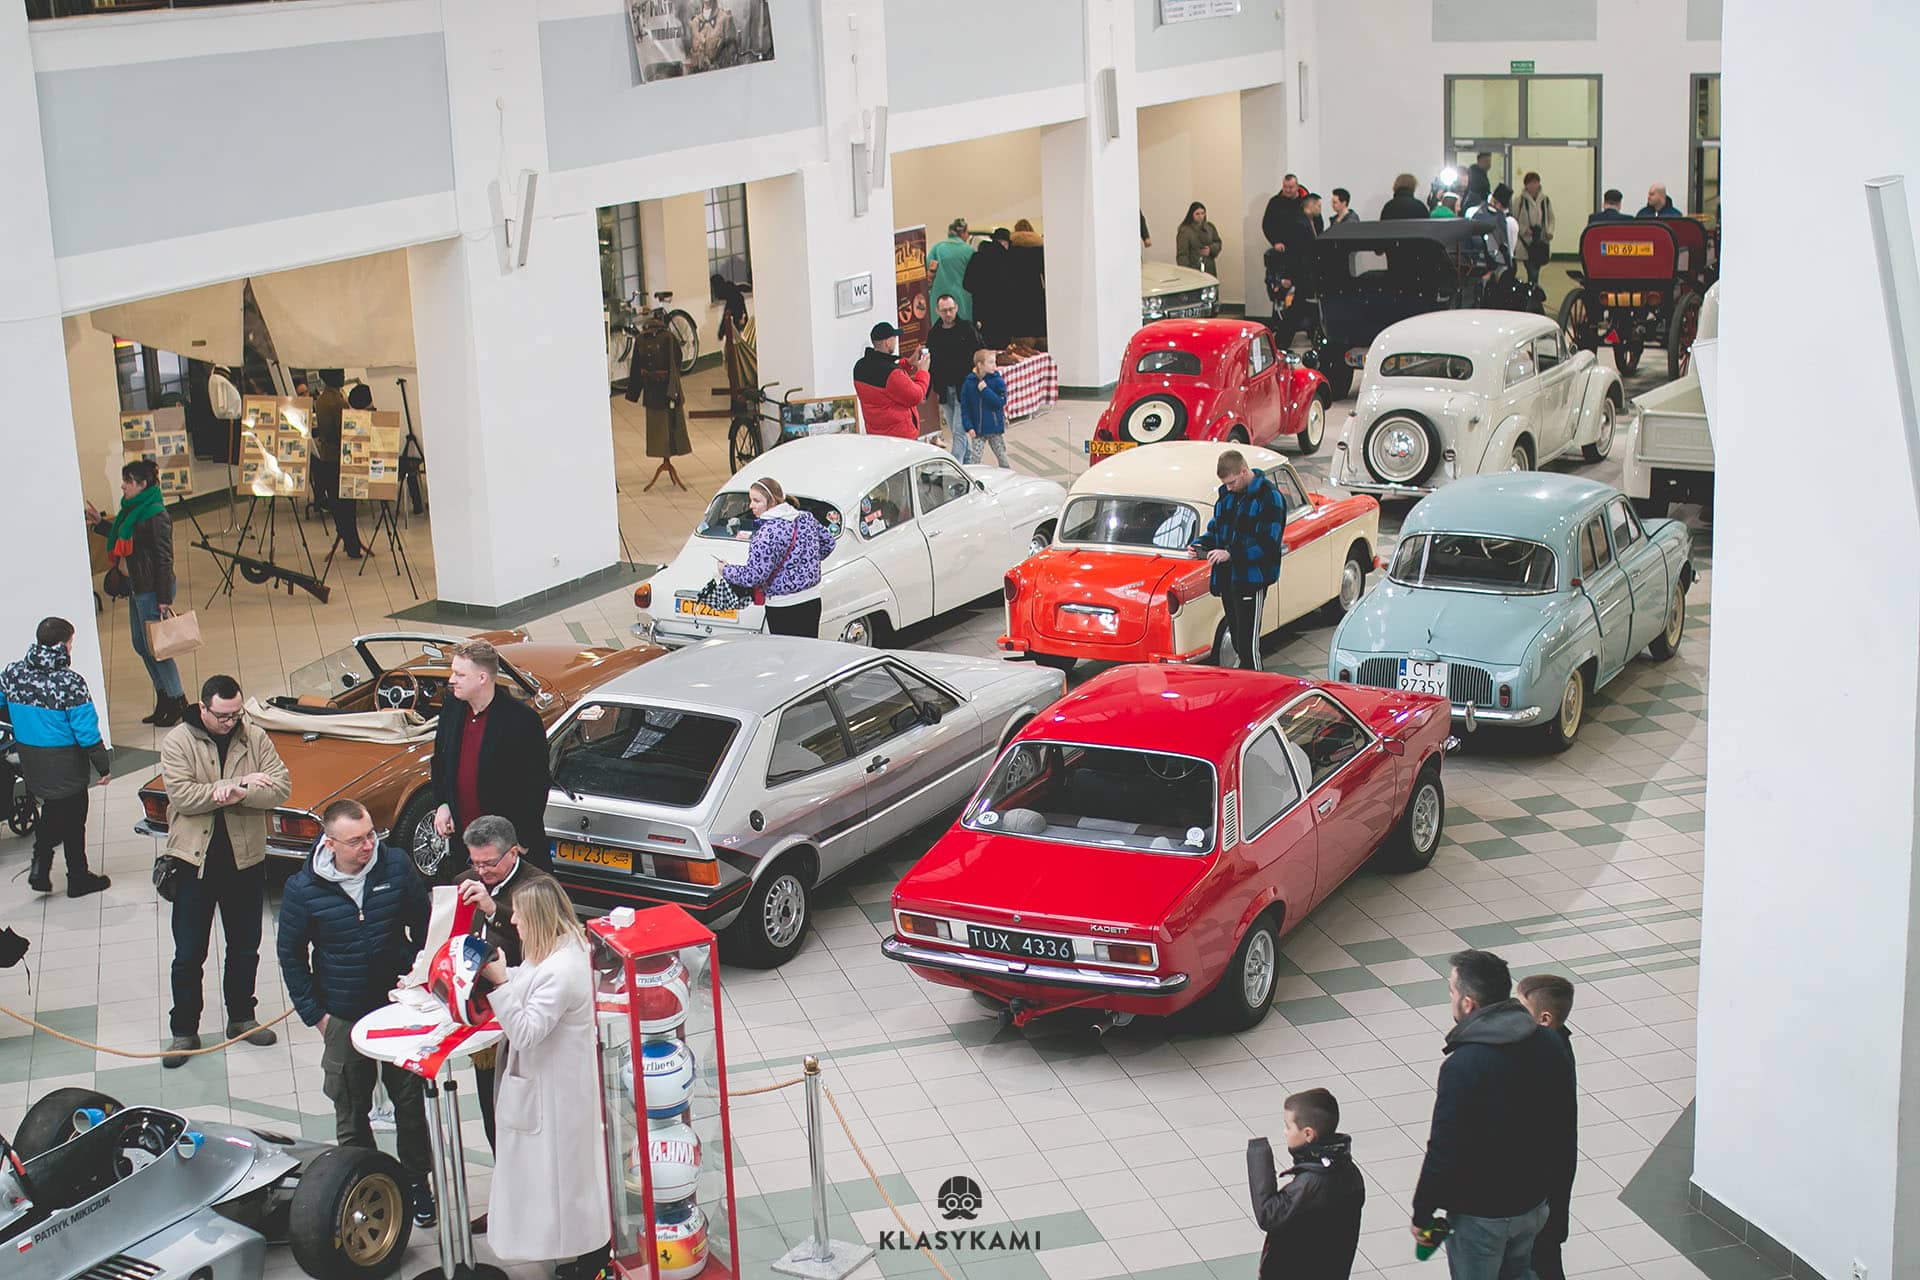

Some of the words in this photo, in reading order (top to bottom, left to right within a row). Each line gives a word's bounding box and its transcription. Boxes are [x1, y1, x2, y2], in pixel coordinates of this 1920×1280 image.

[854, 283, 868, 296] WC
[682, 600, 695, 613] CT
[1413, 662, 1434, 677] CT
[1400, 678, 1444, 696] 9735Y
[982, 814, 993, 822] PL
[558, 842, 577, 860] CT
[583, 844, 610, 865] 23C
[1090, 924, 1129, 935] KADETT
[970, 929, 1011, 951] TUX
[1021, 937, 1071, 959] 4336
[34, 1219, 70, 1244] PATRYK
[70, 1194, 112, 1224] MIKICIUK
